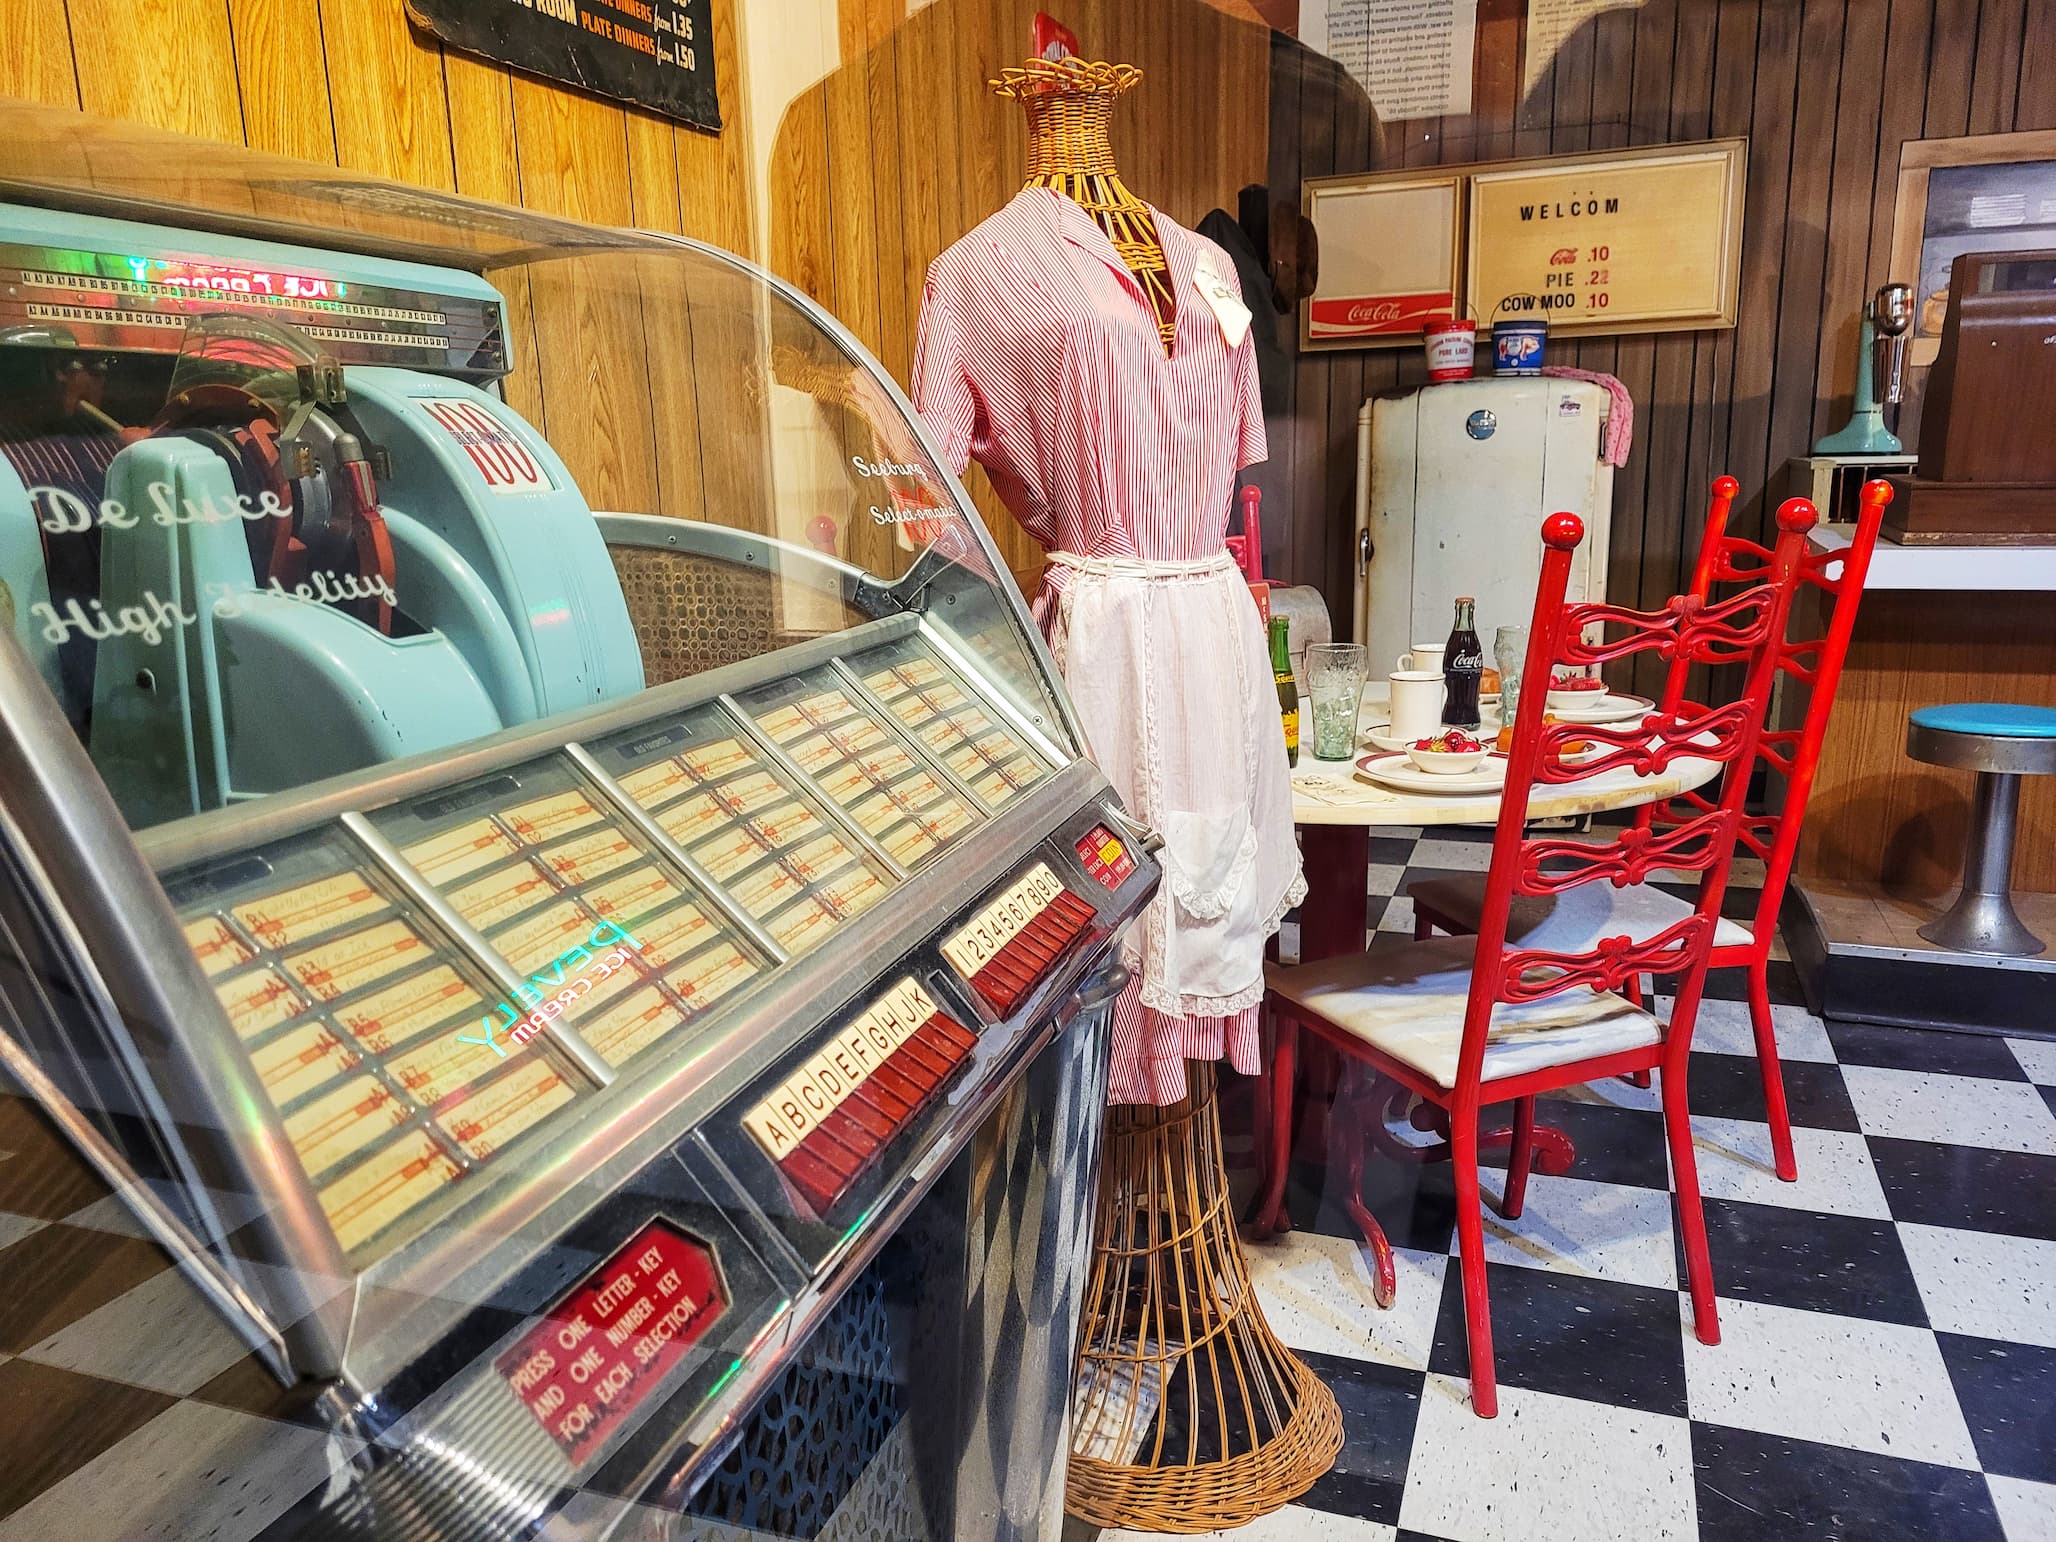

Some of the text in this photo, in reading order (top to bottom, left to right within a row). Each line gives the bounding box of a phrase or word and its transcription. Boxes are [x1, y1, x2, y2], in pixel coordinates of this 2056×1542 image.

[581, 10, 696, 72] PLATE DINNERS from 1.50
[653, 3, 672, 32] from
[672, 10, 694, 40] 1.35
[1520, 198, 1618, 221] WELCOM
[1587, 245, 1610, 263] .10
[1501, 292, 1609, 312] COW MOO .10
[1546, 272, 1574, 288] PIE
[1348, 302, 1402, 322] Coca-Cola
[852, 456, 929, 482] Seeburg
[28, 486, 140, 534] De
[32, 570, 398, 646] High Fdelity
[967, 939, 986, 960] 2
[977, 928, 995, 949] 3
[990, 920, 1005, 938] 4
[998, 911, 1014, 930] 5
[1008, 903, 1024, 921] 6
[1016, 893, 1032, 913] 7
[1027, 887, 1042, 906] 8
[1036, 879, 1051, 896] 9
[765, 987, 932, 1149] A B C D E F G H J K
[509, 1348, 556, 1396] PRESS
[558, 1314, 593, 1351] ONE
[592, 1273, 637, 1319] LETTER
[637, 1245, 665, 1277] KEY
[532, 1385, 566, 1422] AND
[570, 1346, 606, 1384] ONE
[605, 1296, 657, 1349] NUMBER
[656, 1268, 683, 1299] KEY
[559, 1295, 698, 1443] FOR EACH SELECTION
